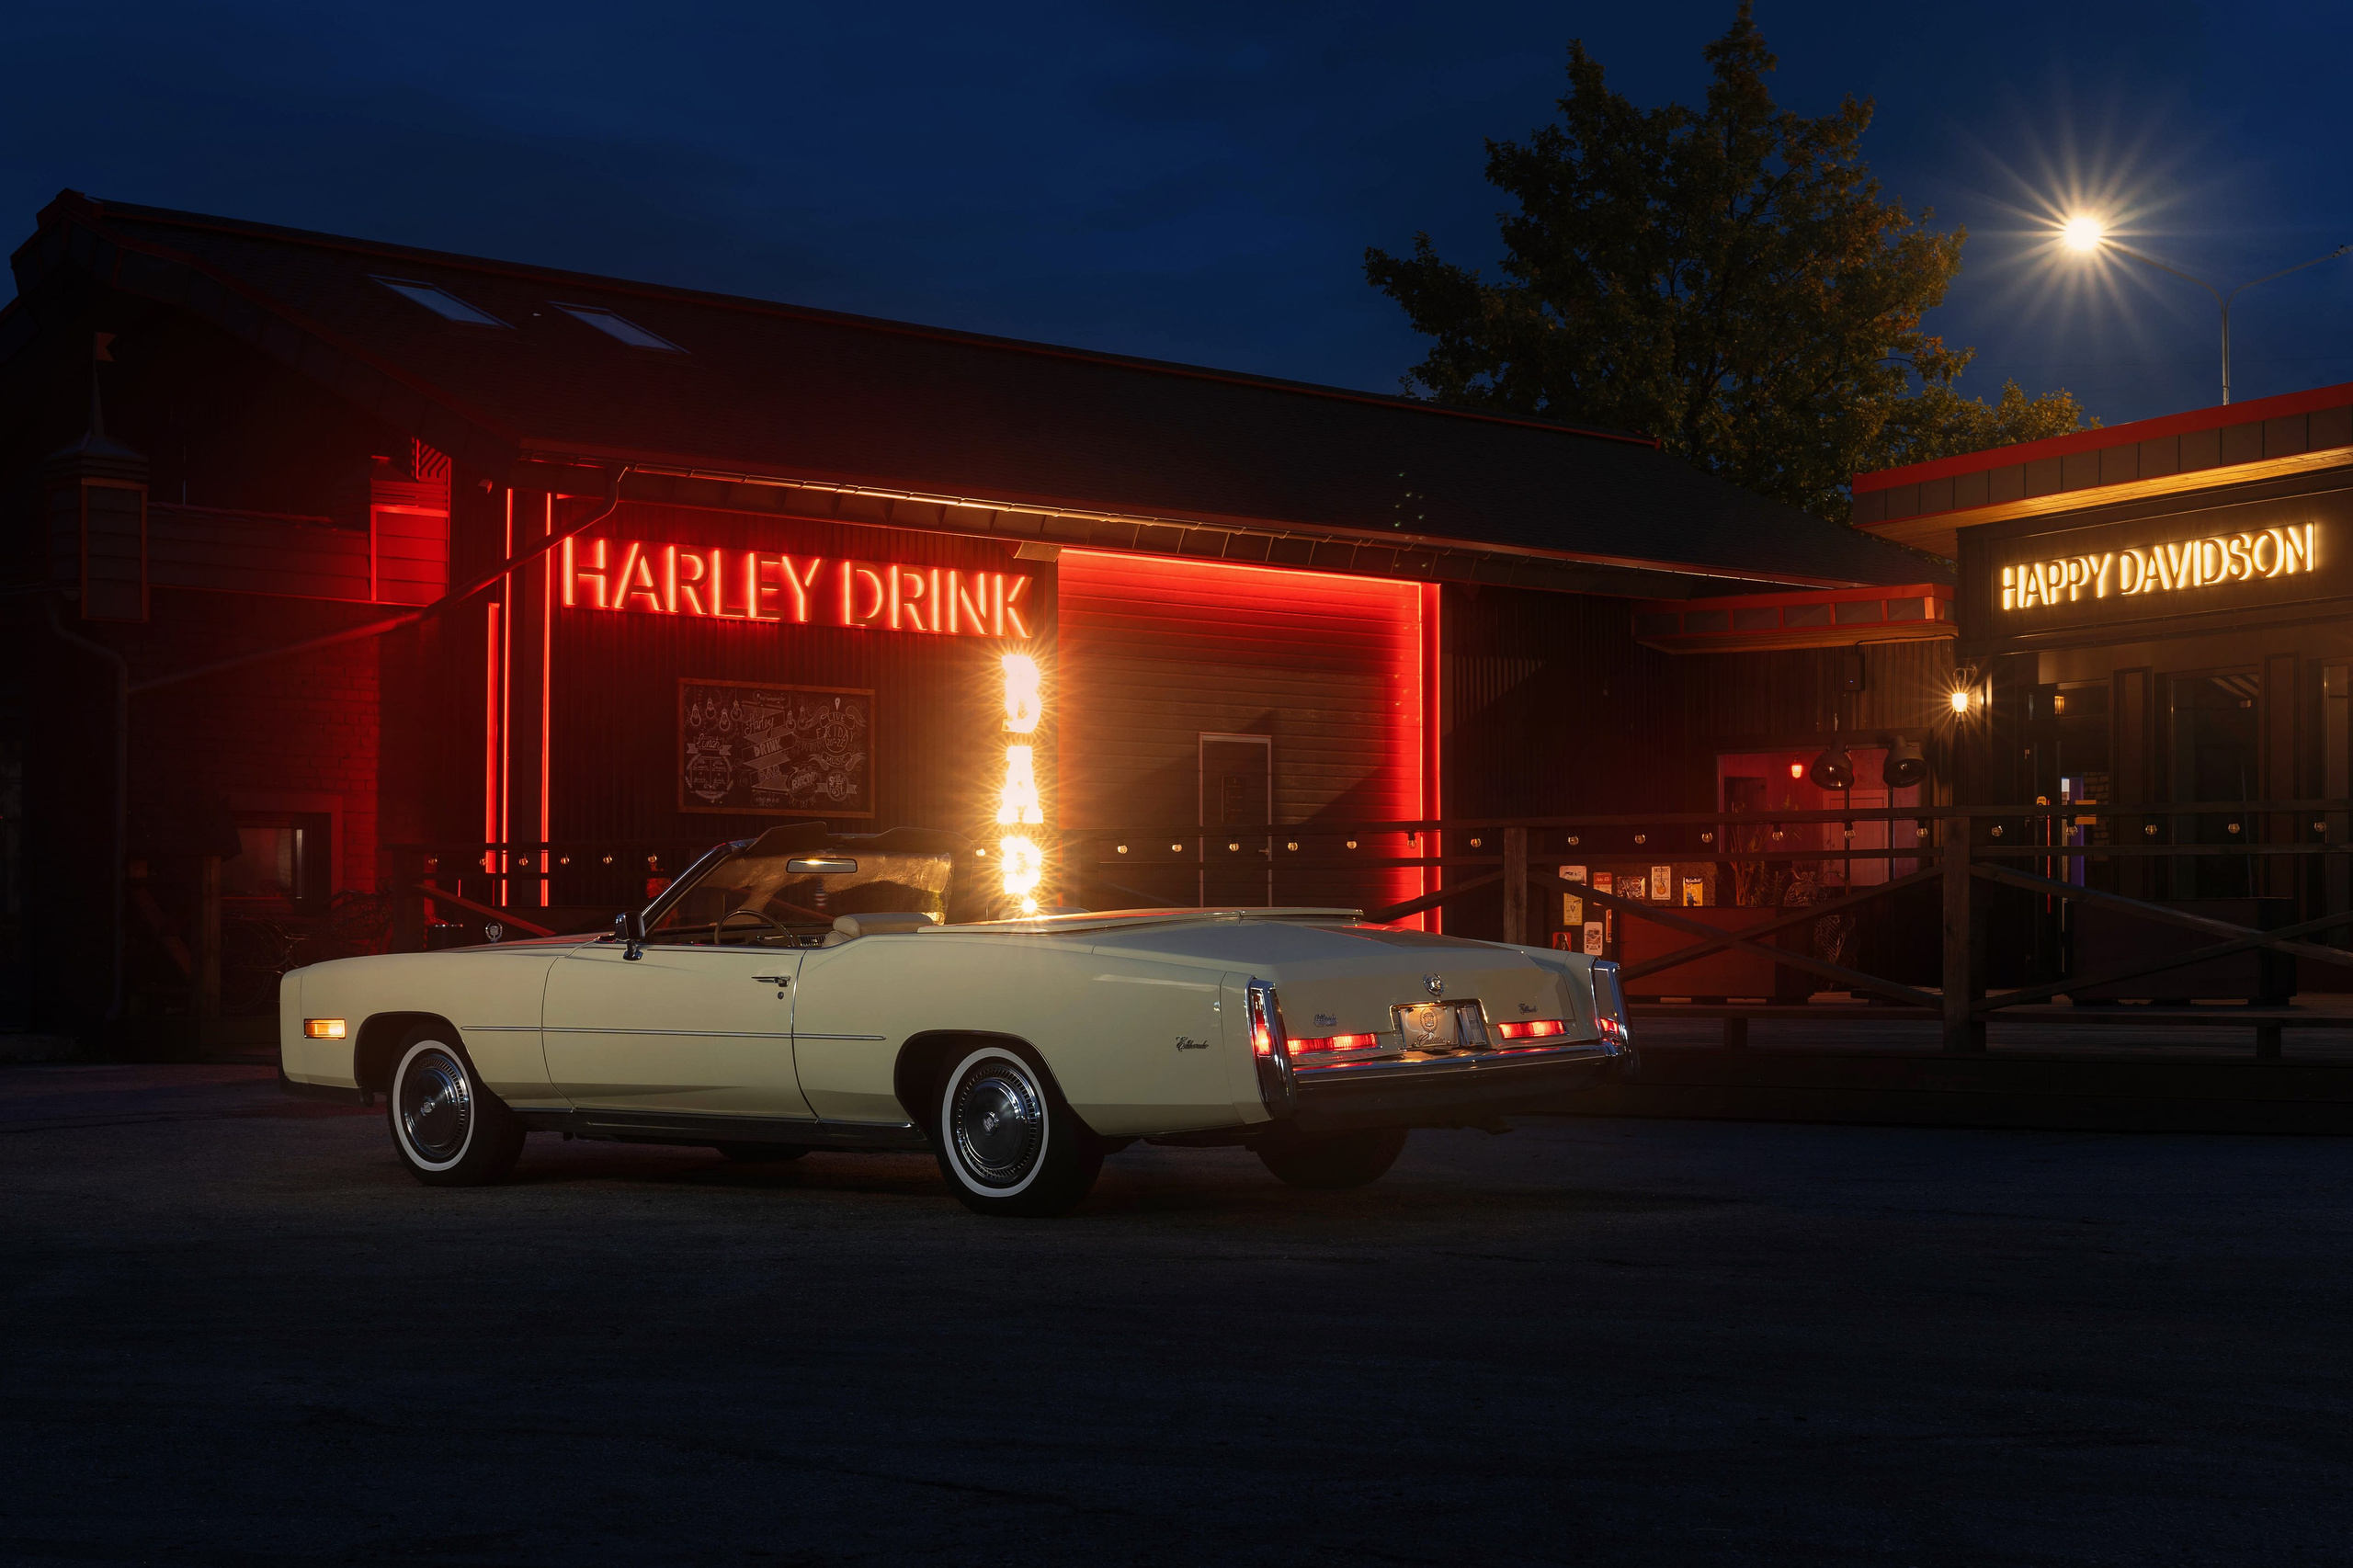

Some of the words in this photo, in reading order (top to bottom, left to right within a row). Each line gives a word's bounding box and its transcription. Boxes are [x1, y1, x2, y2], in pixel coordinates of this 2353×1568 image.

[2002, 552, 2111, 611] HAPPY
[2120, 522, 2313, 596] DAVIDSON
[563, 536, 824, 623] HARLEY
[843, 560, 1033, 639] DRINK
[827, 712, 847, 722] LIVE
[815, 725, 857, 743] FRIDAY
[753, 738, 783, 757] DRINK
[825, 756, 848, 765] MUSIC
[756, 764, 783, 782] BAR
